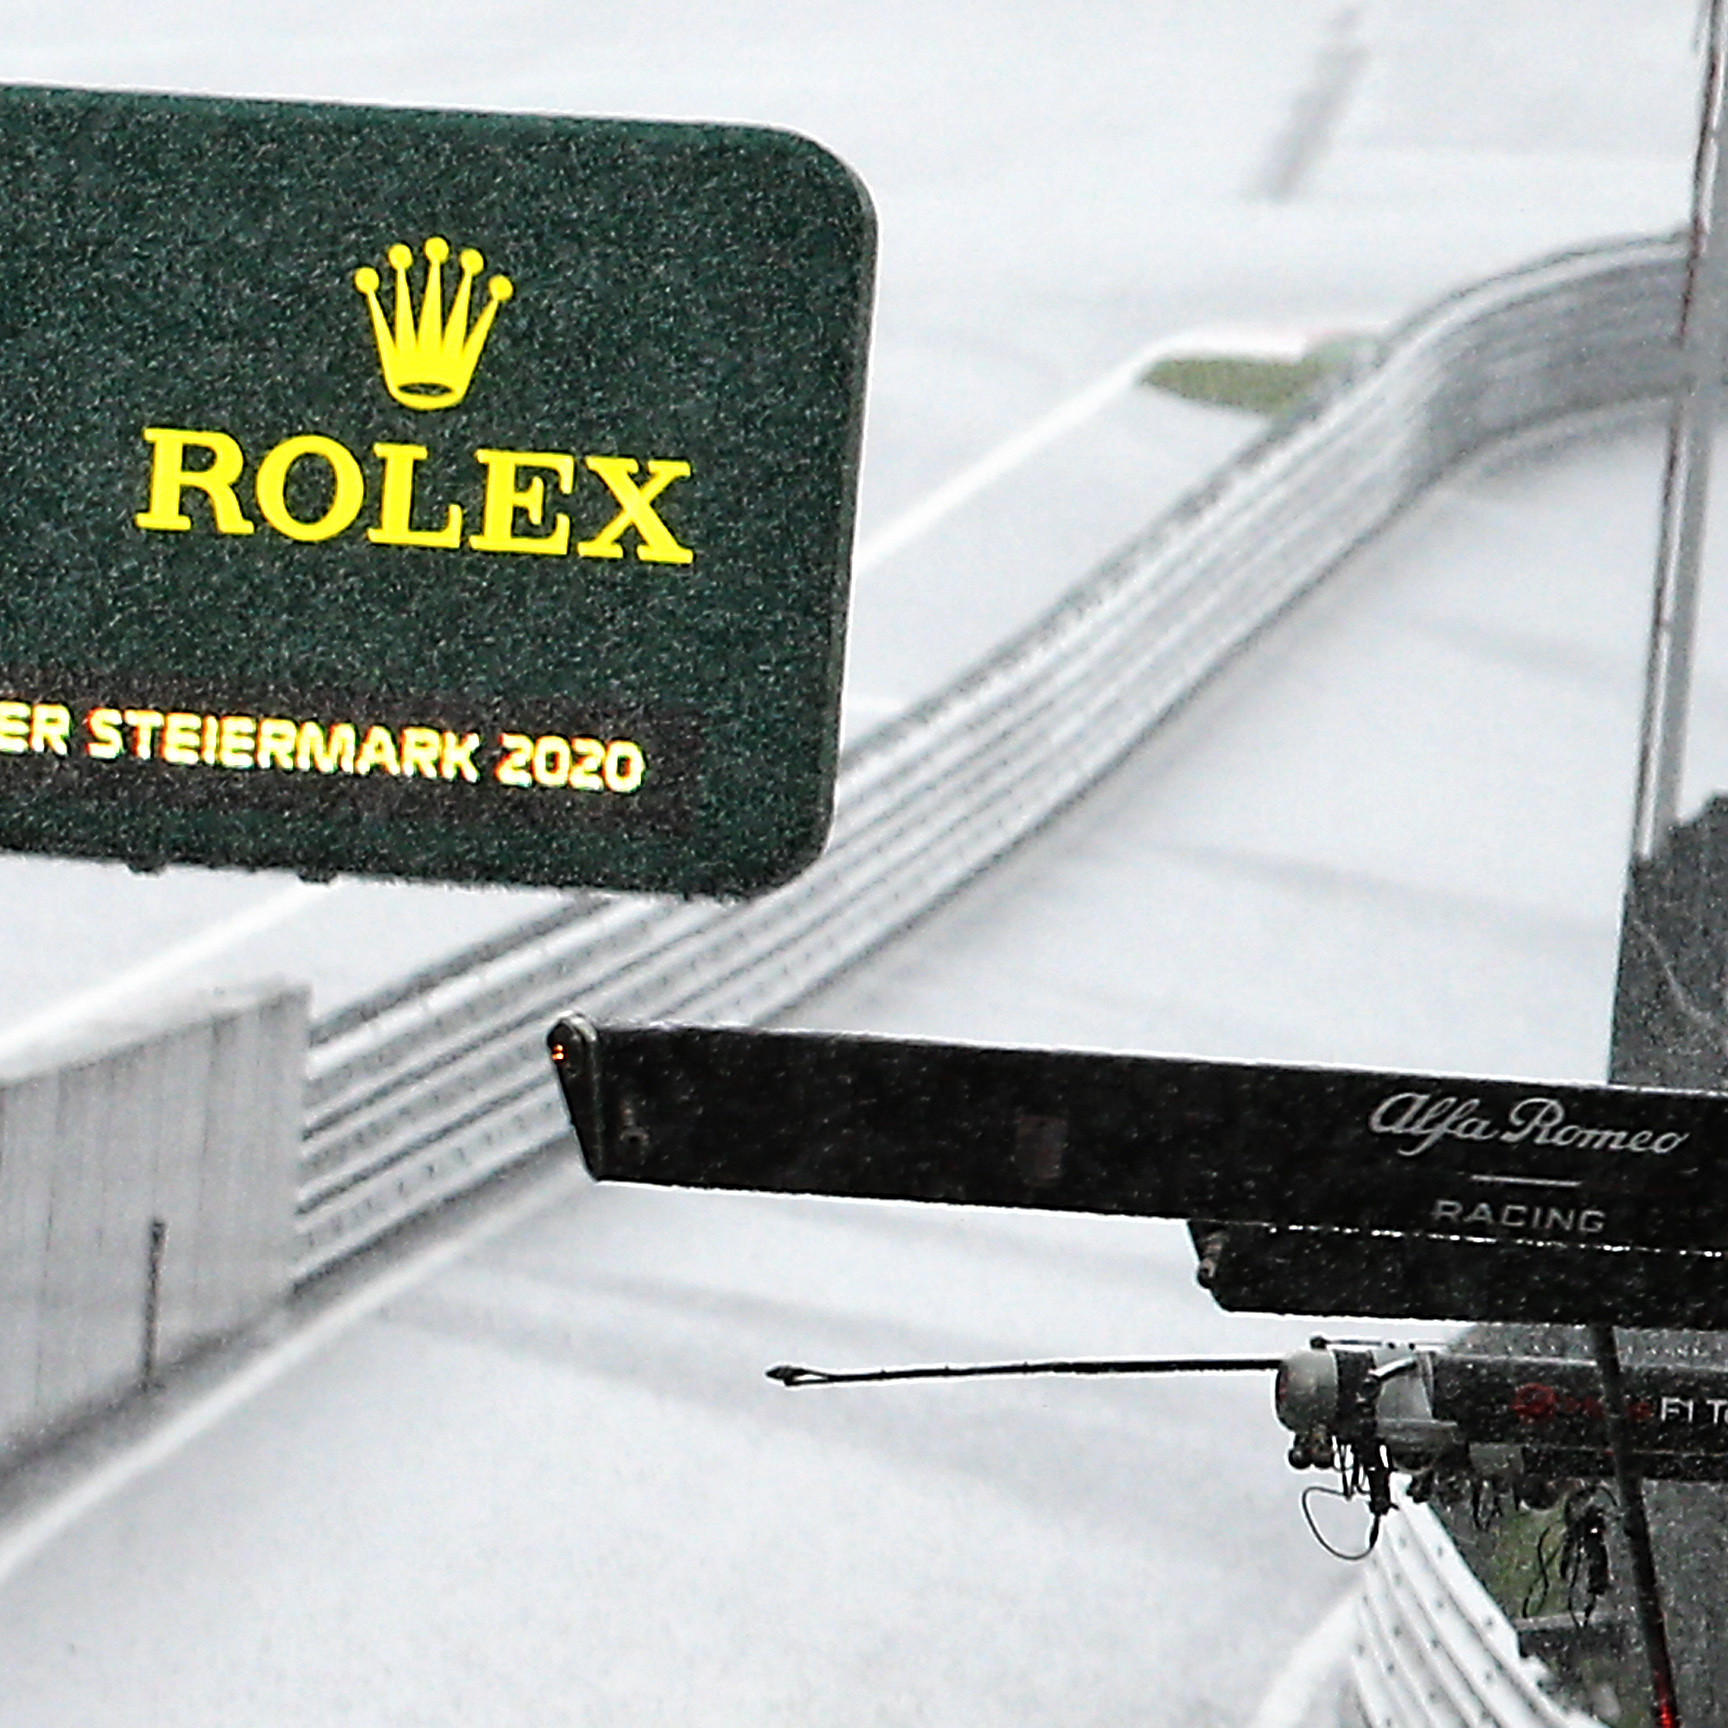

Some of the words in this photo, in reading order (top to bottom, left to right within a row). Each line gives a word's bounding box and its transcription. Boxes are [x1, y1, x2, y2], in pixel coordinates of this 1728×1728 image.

[135, 427, 694, 565] ROLEX
[85, 707, 481, 783] STEIERMARK
[495, 732, 646, 793] 2020
[1367, 1091, 1500, 1156] Alfa
[1499, 1097, 1691, 1154] Romeo
[1433, 1199, 1608, 1233] RACING
[1660, 1396, 1694, 1422] F1
[1706, 1398, 1728, 1425] T
